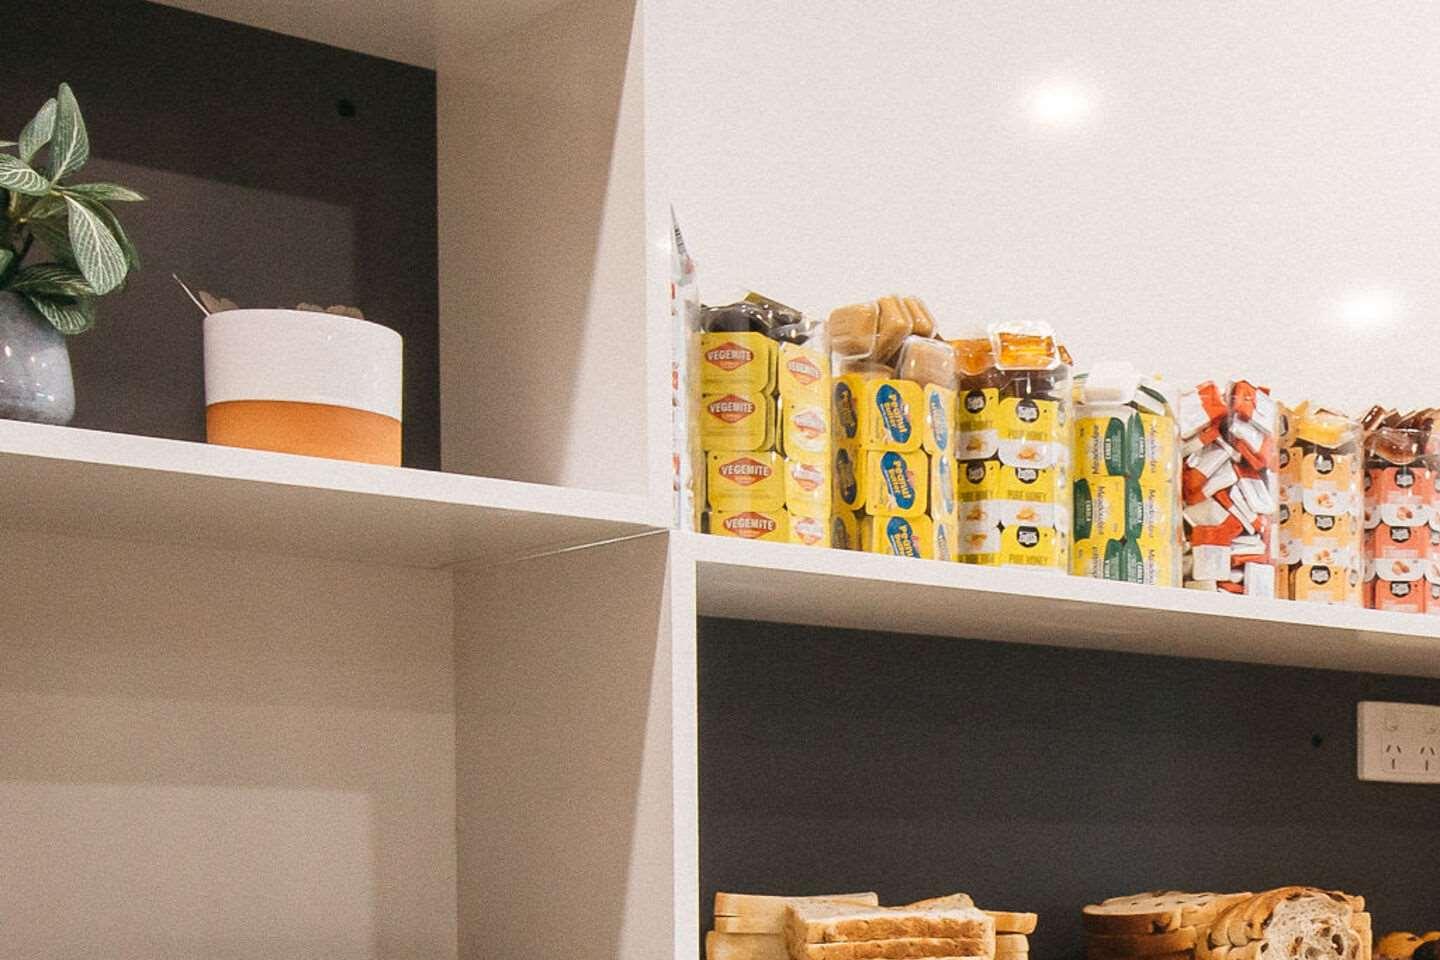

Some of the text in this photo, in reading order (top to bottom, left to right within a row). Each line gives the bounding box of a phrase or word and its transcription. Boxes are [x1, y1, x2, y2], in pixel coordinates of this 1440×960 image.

[706, 349, 752, 361] VEGEMITE
[709, 401, 754, 413] VEGEMITE
[720, 464, 770, 477] VEGEMITE
[725, 518, 775, 530] VEGEMITE
